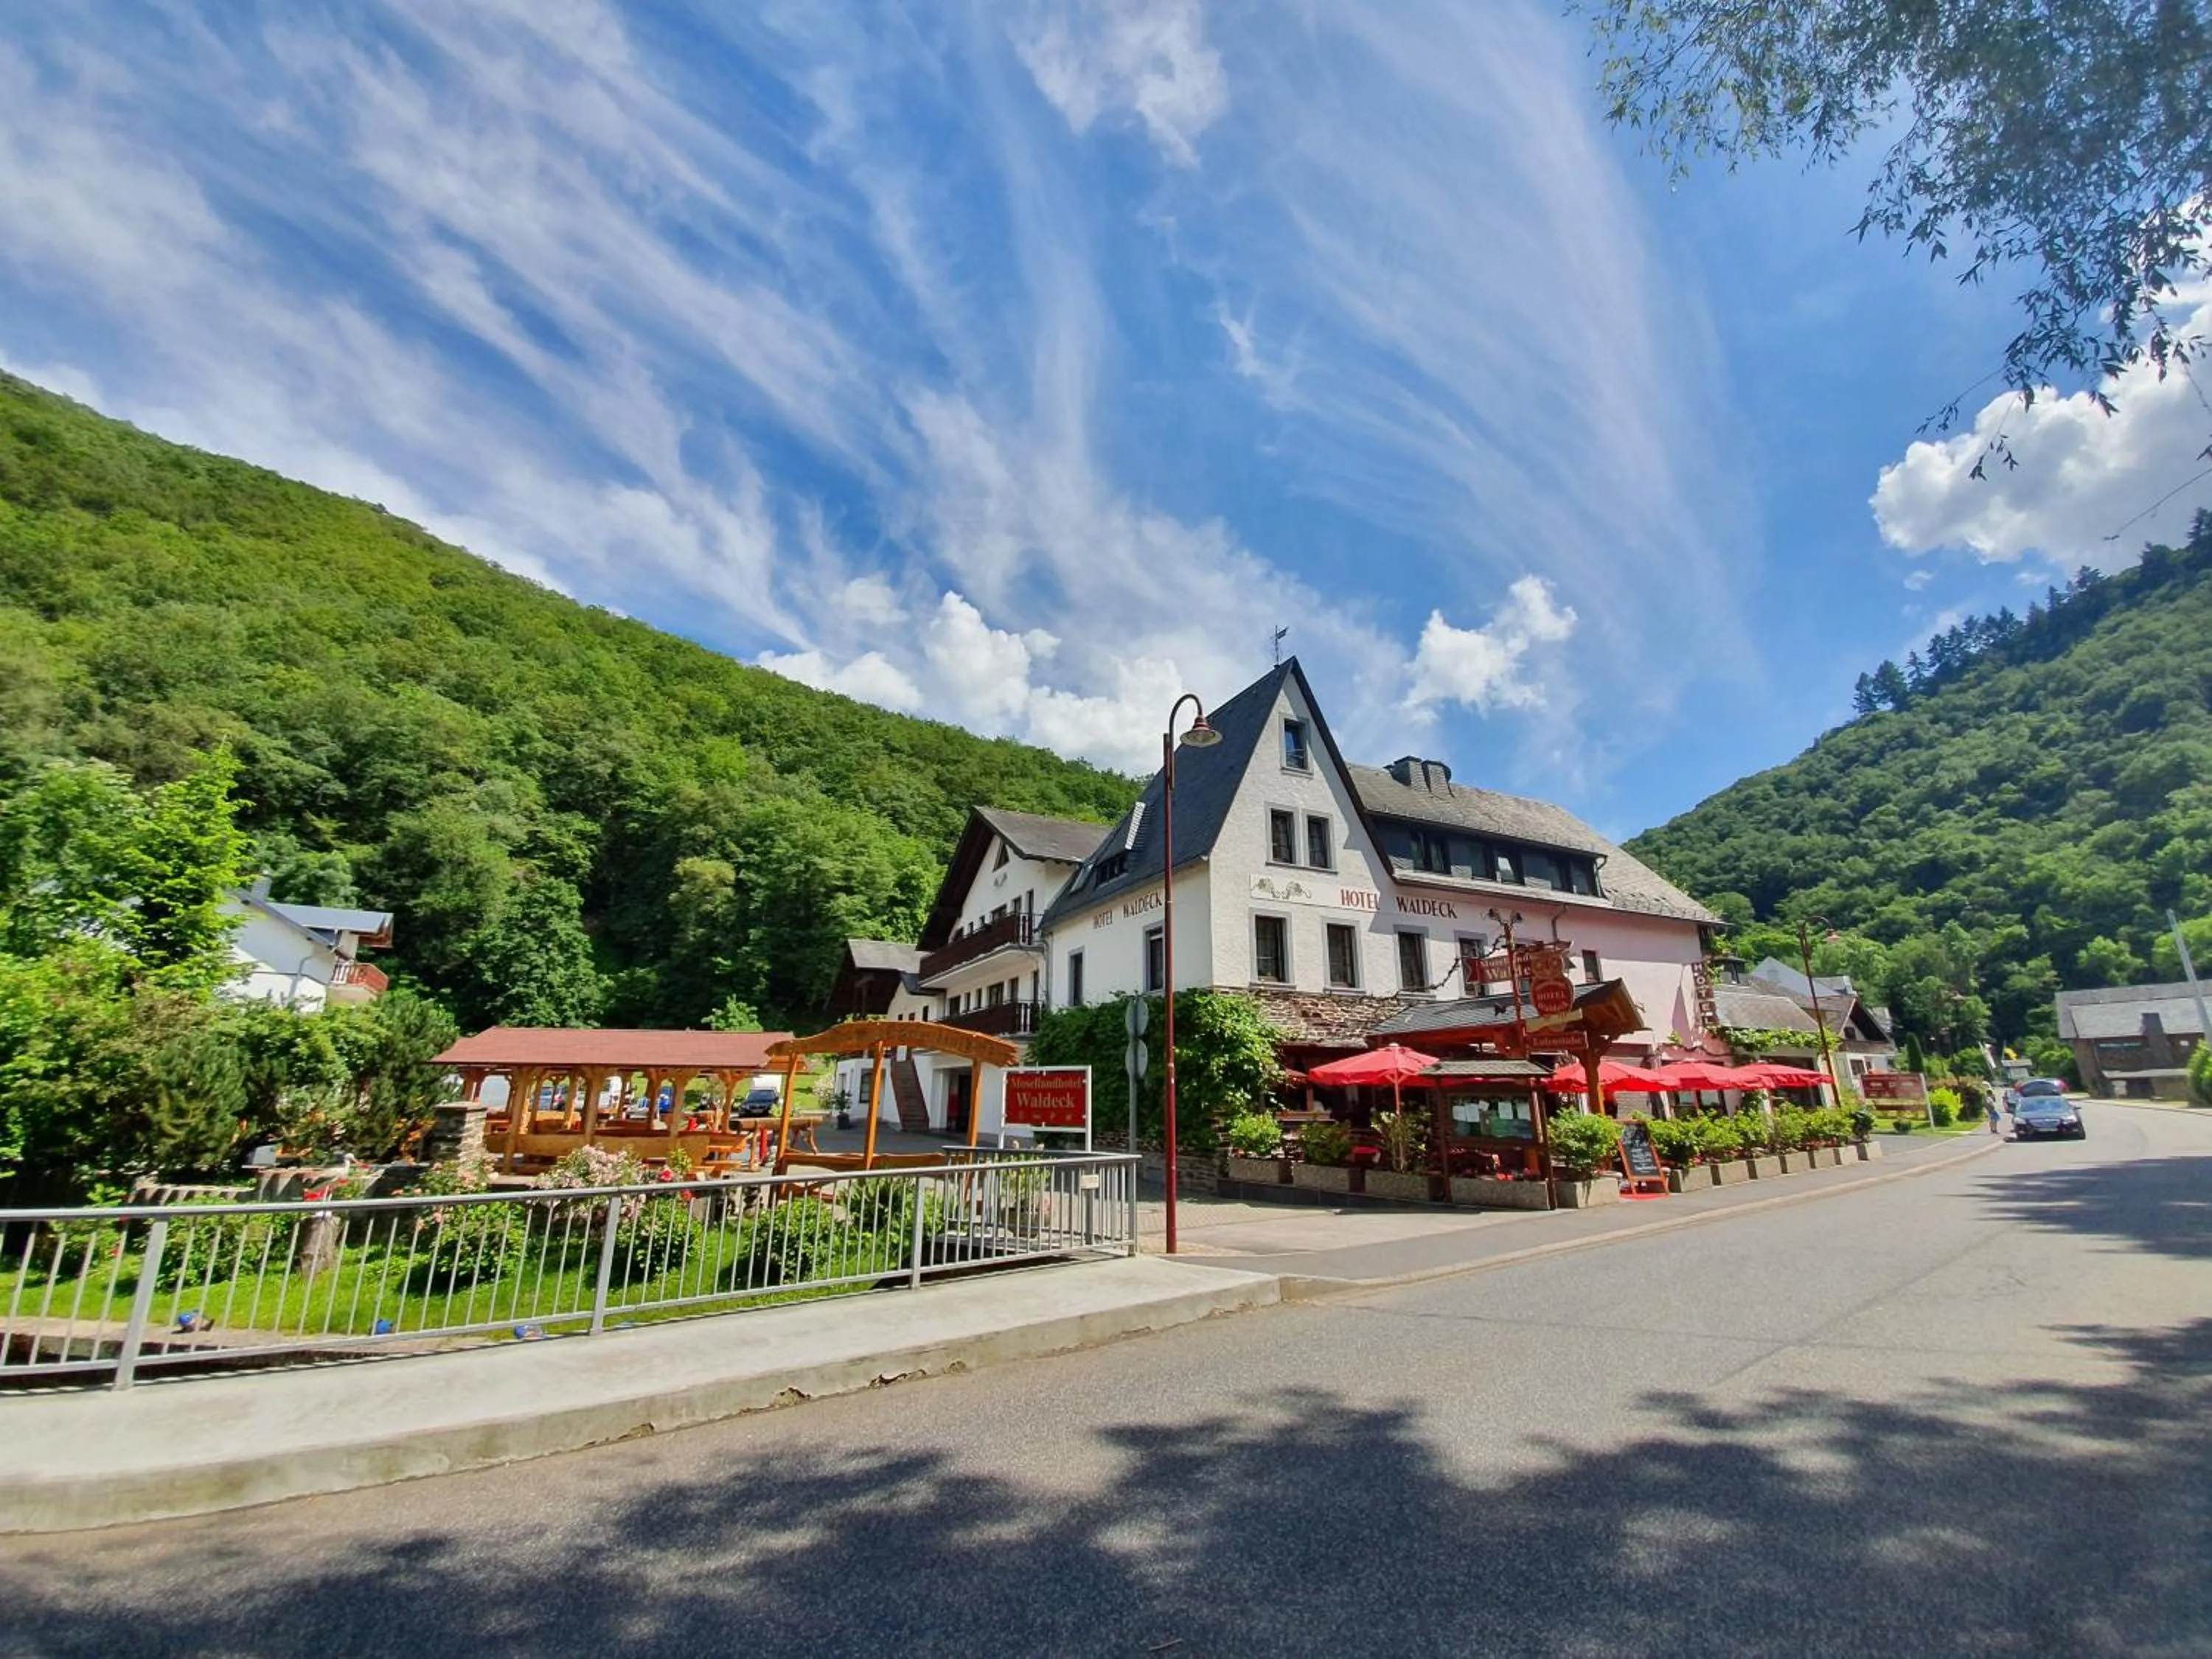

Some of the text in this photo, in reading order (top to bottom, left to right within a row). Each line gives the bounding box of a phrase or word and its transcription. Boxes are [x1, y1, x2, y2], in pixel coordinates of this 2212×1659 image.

[1094, 891, 1163, 929] HOTEL WALDECK
[1341, 888, 1458, 919] HOTEL WALDECK
[1537, 990, 1565, 1001] HOTEL
[1693, 964, 1717, 1025] HOTEL
[1011, 1077, 1082, 1089] Mosellandhotel
[1017, 1092, 1074, 1107] Waldeck
